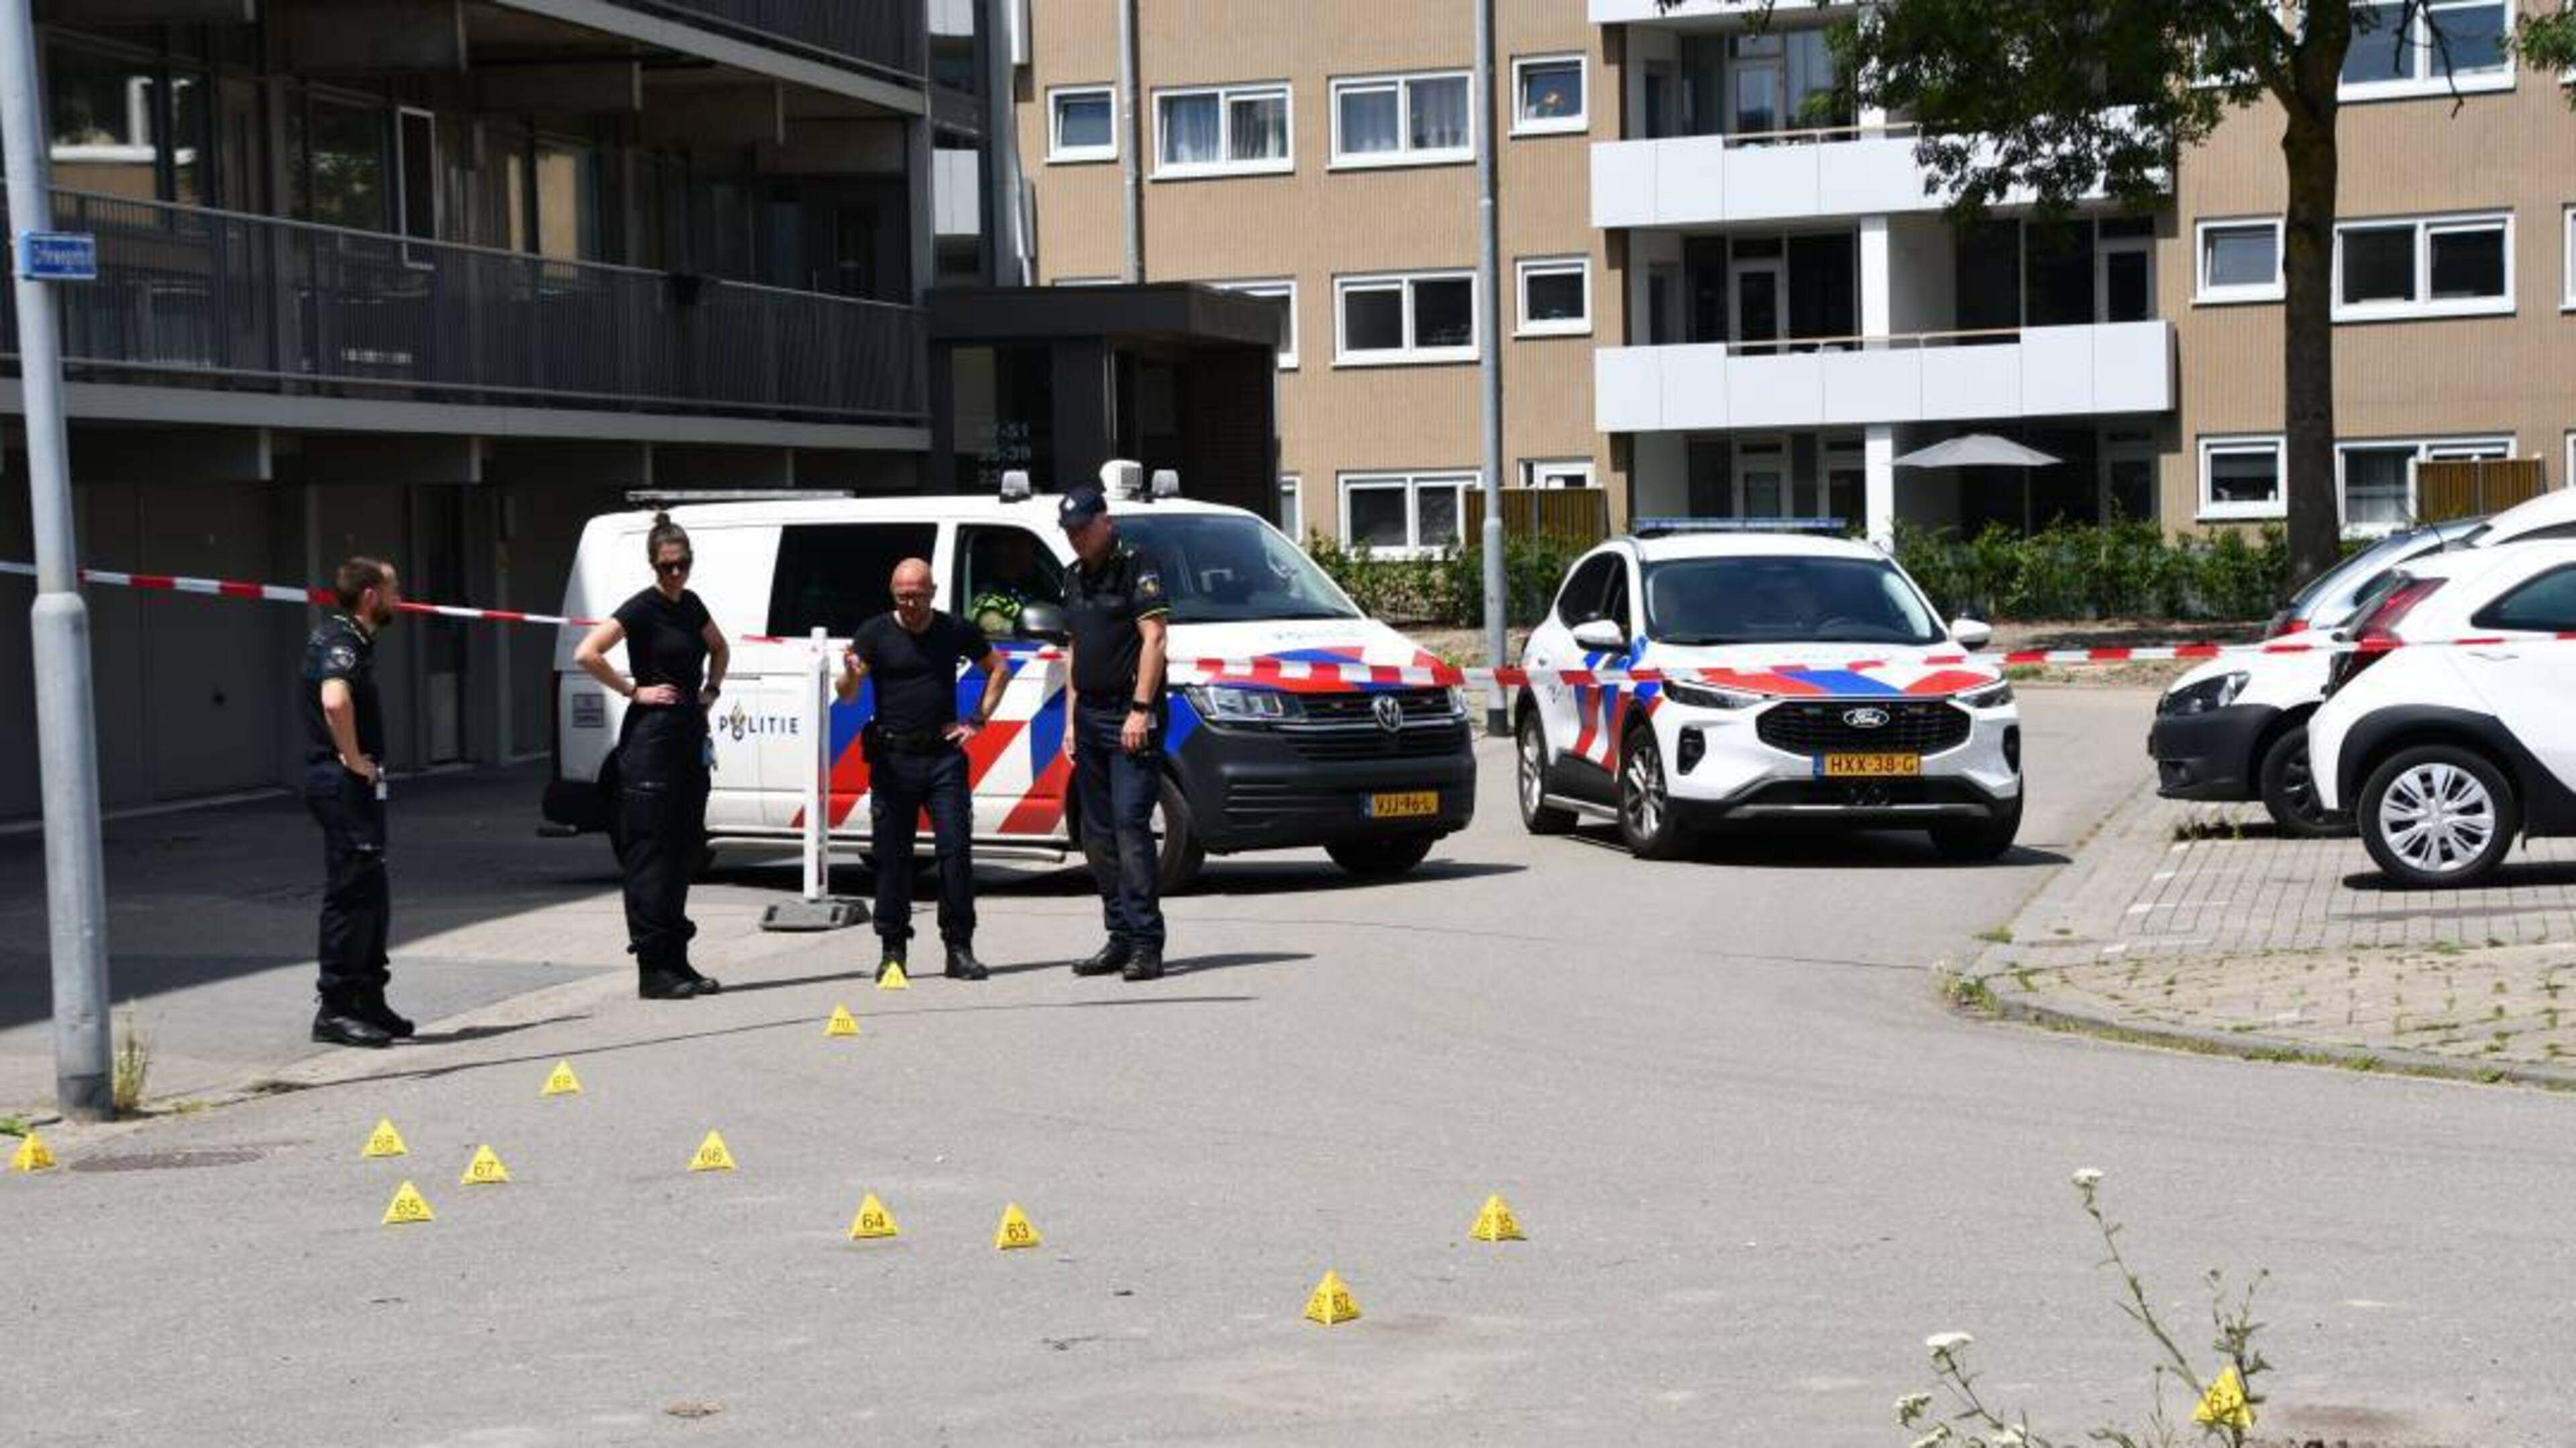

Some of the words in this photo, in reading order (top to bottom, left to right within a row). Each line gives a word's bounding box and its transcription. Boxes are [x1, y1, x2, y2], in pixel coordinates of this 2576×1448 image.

[718, 713, 800, 741] POLITIE
[1830, 756, 1915, 773] HXX-38-G
[474, 1161, 495, 1176] 67
[395, 1200, 421, 1215] 65
[862, 1213, 885, 1229] 64
[1007, 1222, 1030, 1241] 63
[1332, 1292, 1352, 1313] 62
